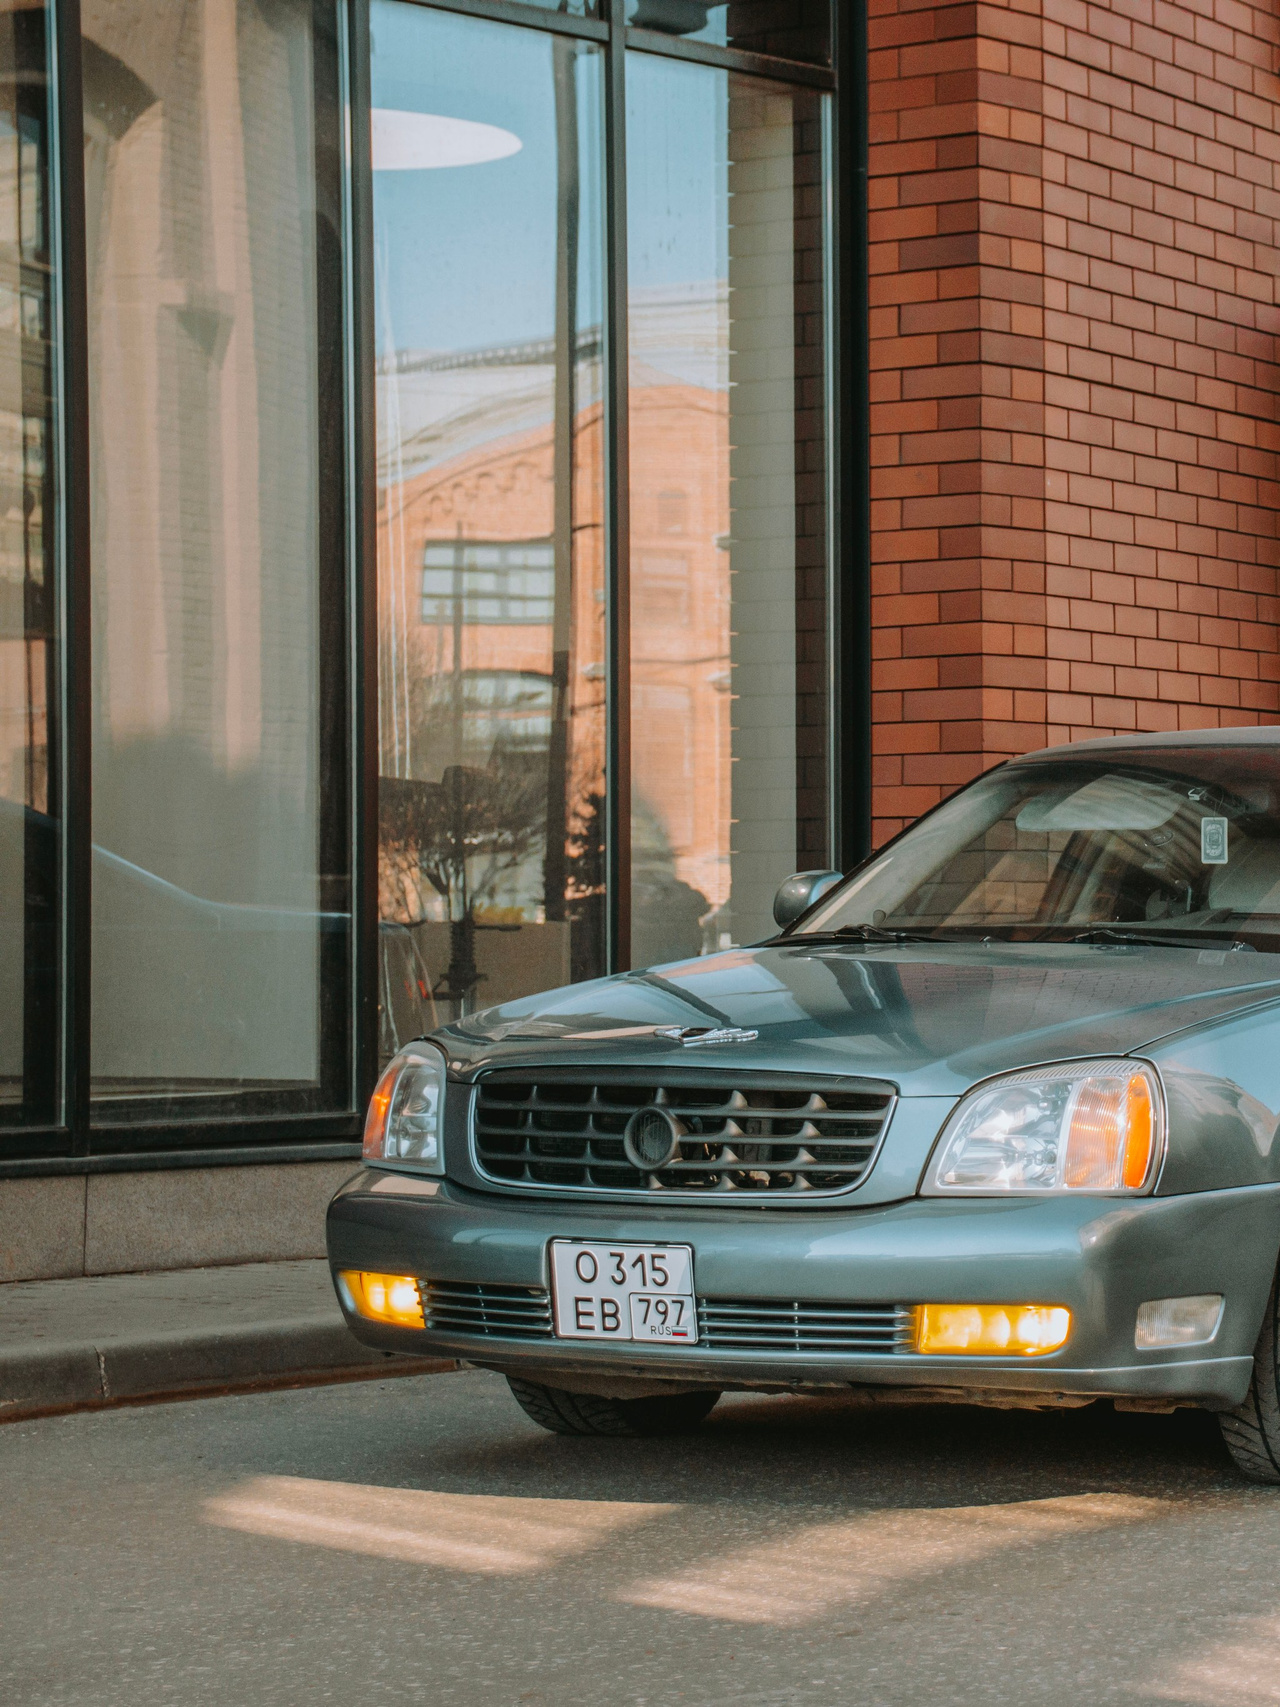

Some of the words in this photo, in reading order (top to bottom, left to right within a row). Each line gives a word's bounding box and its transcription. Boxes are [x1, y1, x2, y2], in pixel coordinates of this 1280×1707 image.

[610, 1251, 670, 1287] 315
[638, 1298, 685, 1325] 797
[651, 1325, 672, 1336] RUS
